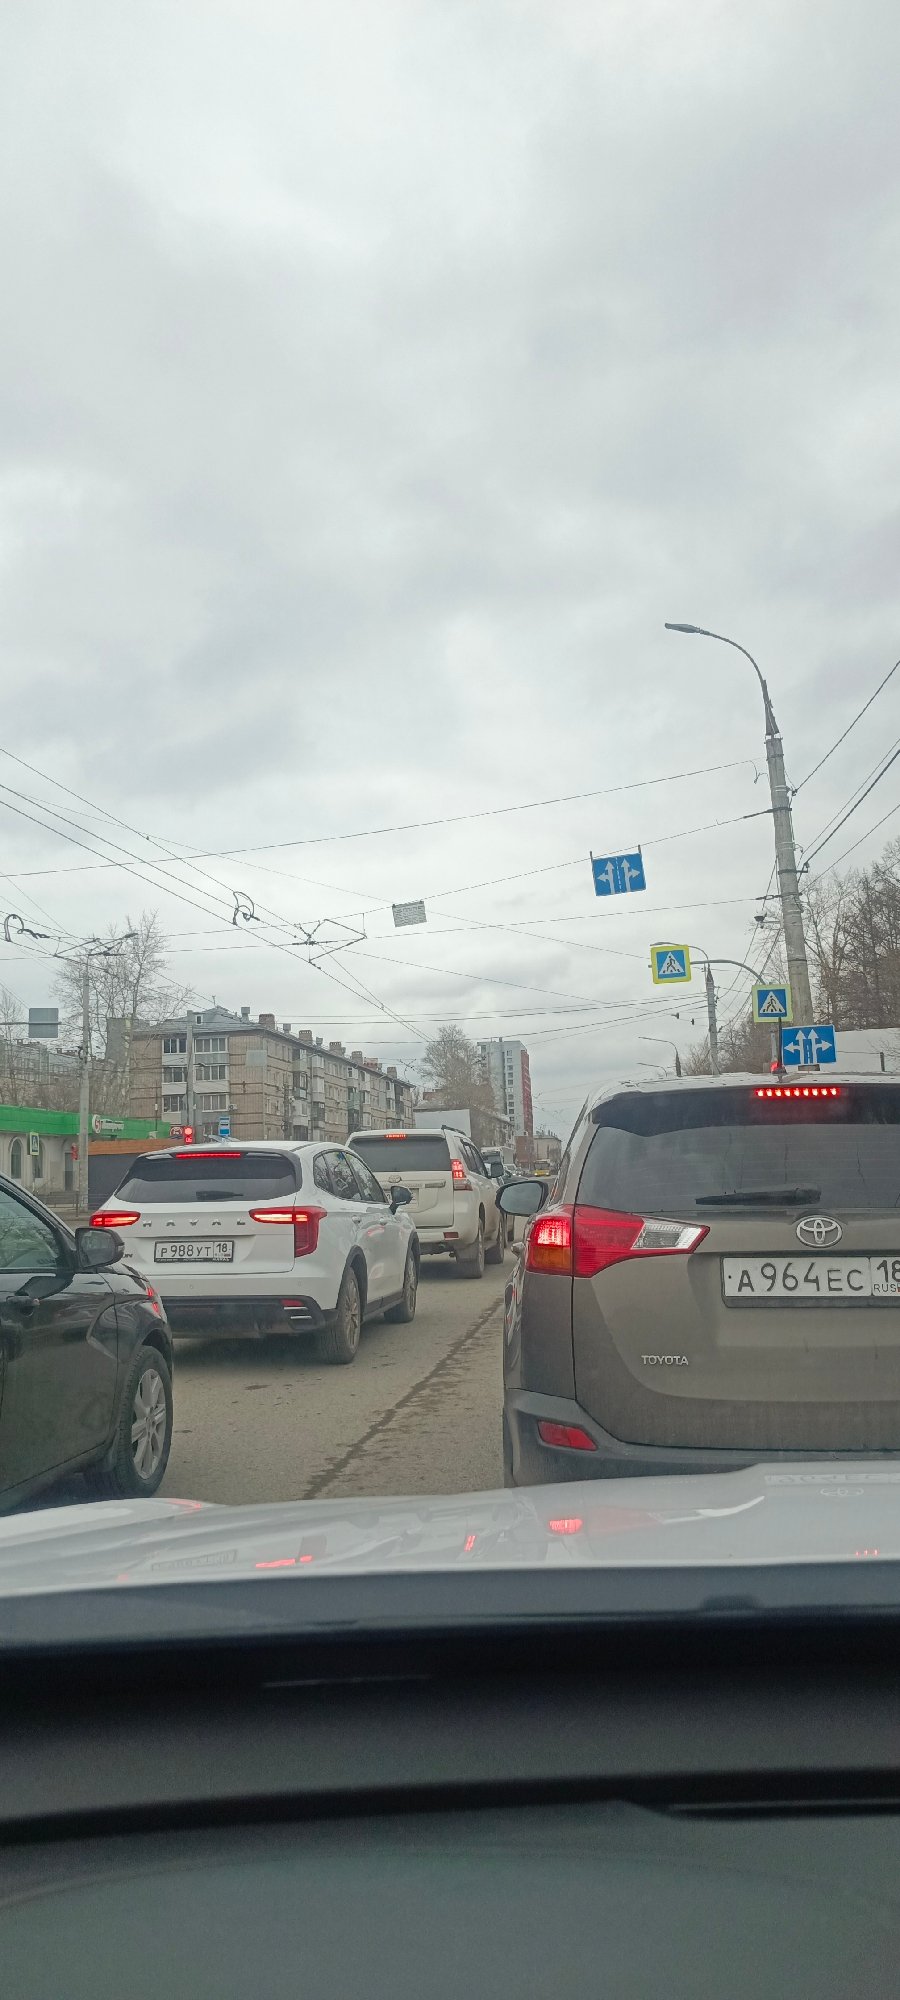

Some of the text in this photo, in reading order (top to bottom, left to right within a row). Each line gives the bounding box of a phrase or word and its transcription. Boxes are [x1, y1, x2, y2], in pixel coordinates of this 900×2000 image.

[216, 1243, 228, 1253] 18
[738, 1262, 864, 1292] А964ЕС
[873, 1283, 897, 1293] RUS
[641, 1355, 689, 1366] TOYOTA
